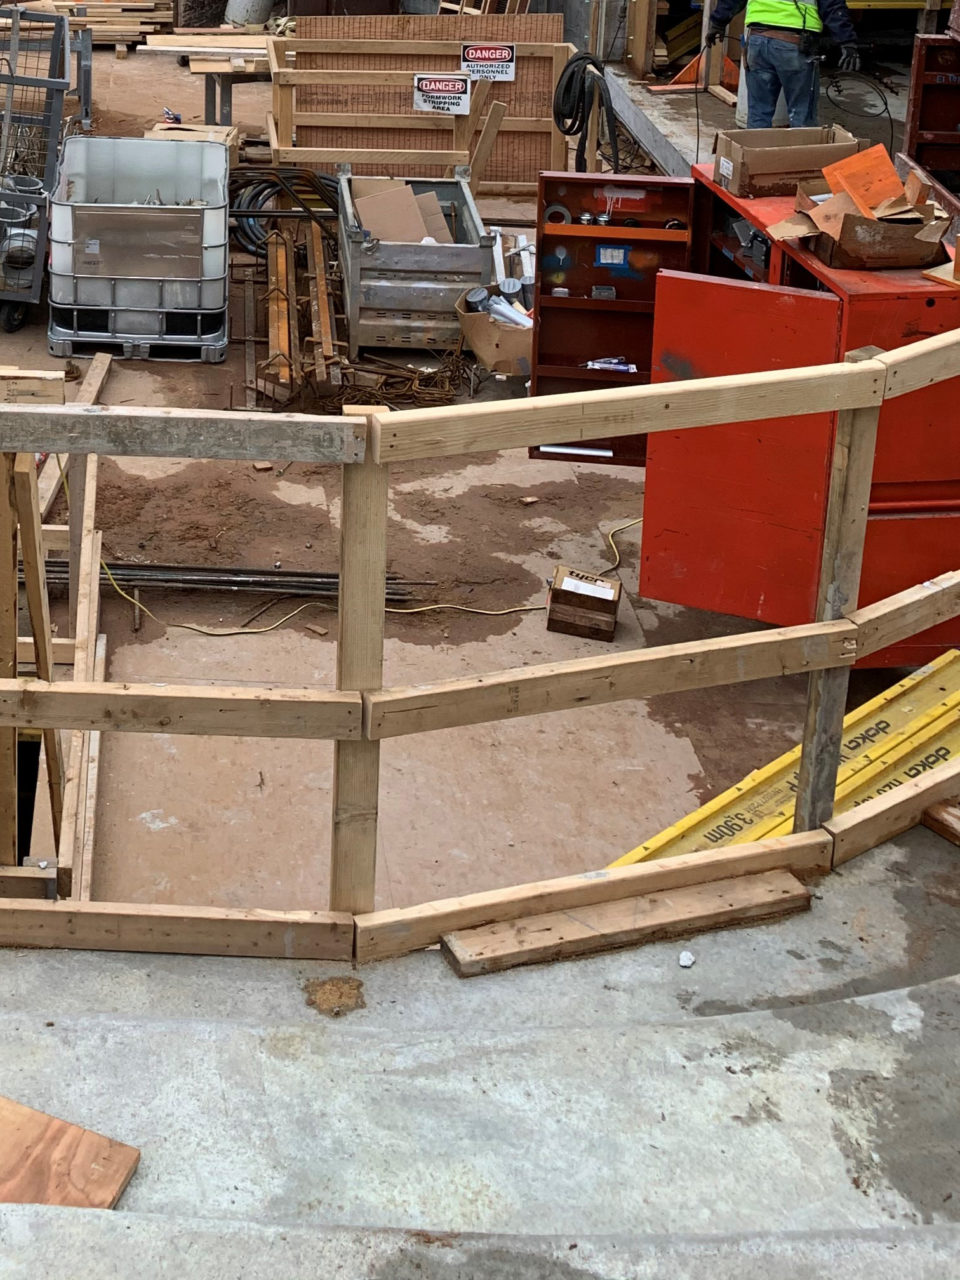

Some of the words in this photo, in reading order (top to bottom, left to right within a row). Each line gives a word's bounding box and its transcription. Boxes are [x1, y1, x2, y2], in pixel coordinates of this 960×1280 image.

[468, 49, 509, 59] DANGER
[422, 81, 463, 91] DANGER
[421, 93, 463, 101] FORMWORK
[422, 99, 461, 107] STRIPPING
[843, 720, 891, 751] doka
[903, 746, 951, 778] doka
[703, 812, 755, 844] 3,90m
